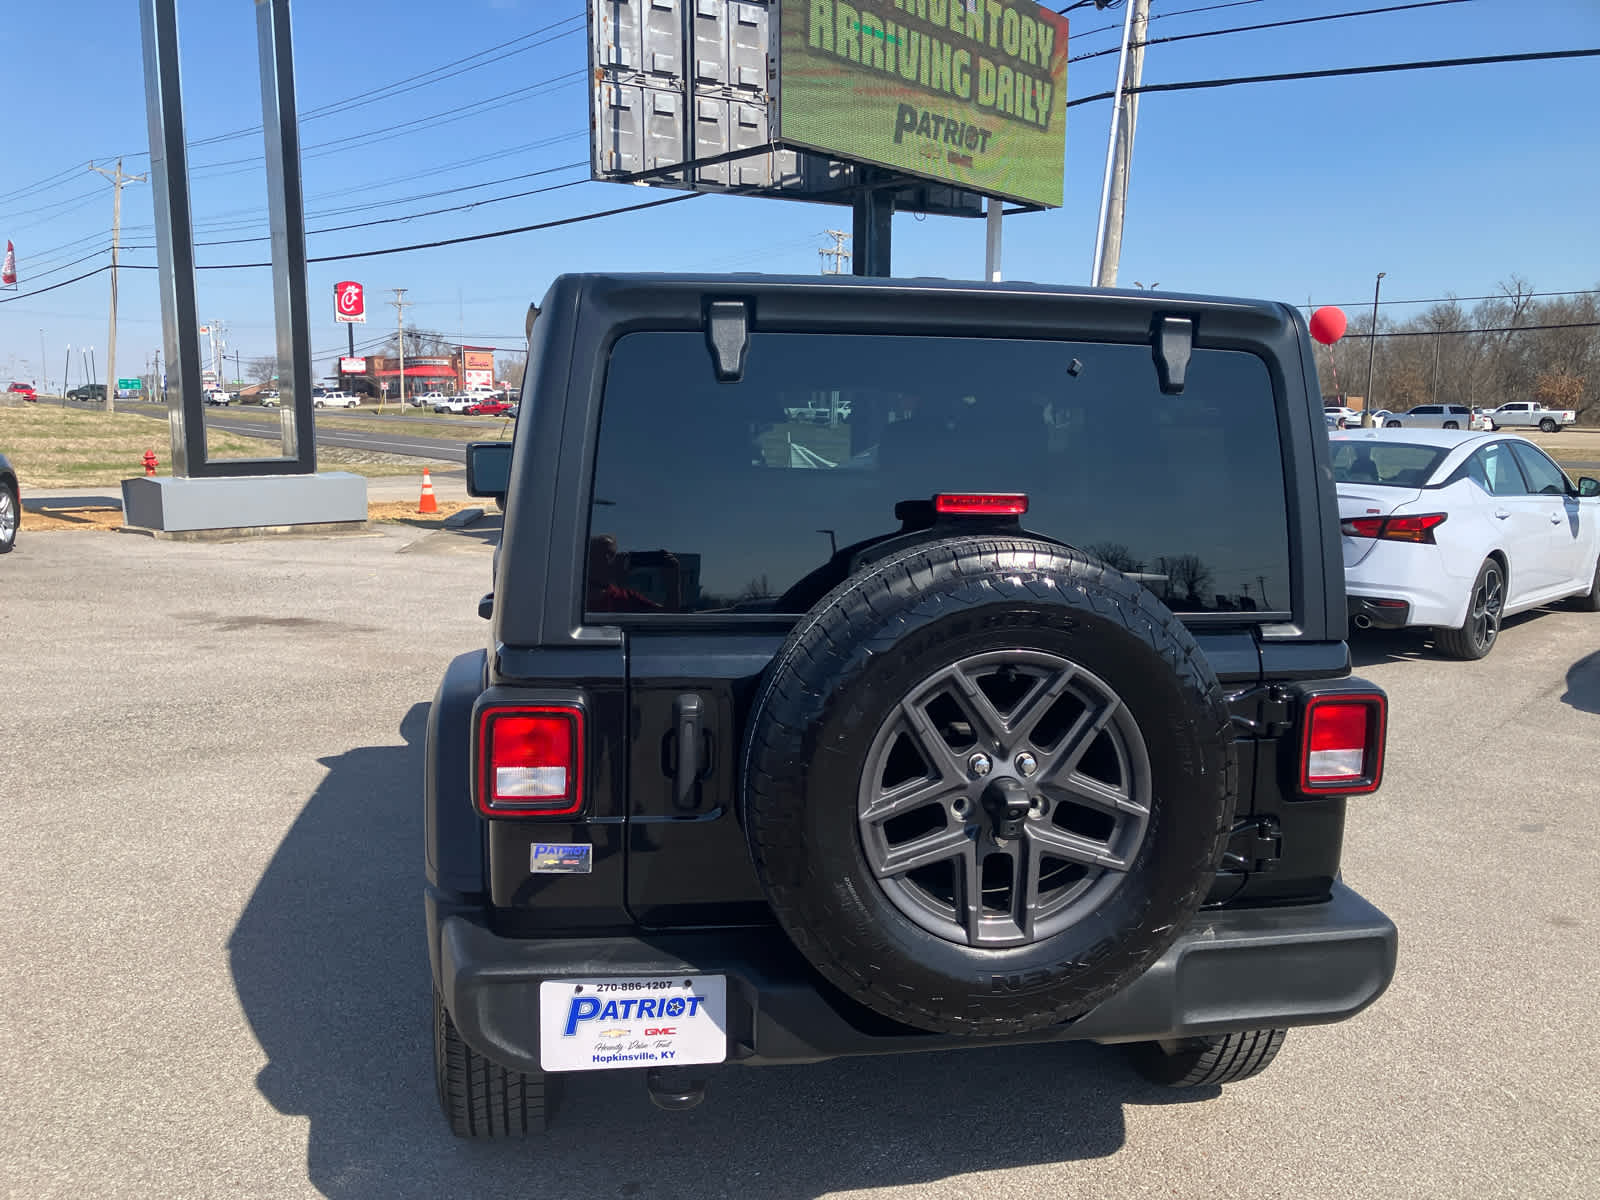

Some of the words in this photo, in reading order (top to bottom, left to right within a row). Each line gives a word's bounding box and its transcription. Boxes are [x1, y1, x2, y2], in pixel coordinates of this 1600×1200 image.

[895, 0, 1055, 69] VENTORY
[808, 0, 971, 98] ARRIVING
[978, 55, 1051, 126] DAILY
[894, 102, 992, 152] PATRIOT
[596, 981, 673, 992] 270-886-1207
[563, 996, 705, 1036] PATRIOT
[644, 1027, 677, 1036] GMC
[592, 1052, 658, 1063] Hopkinsville,
[661, 1050, 676, 1059] KY
